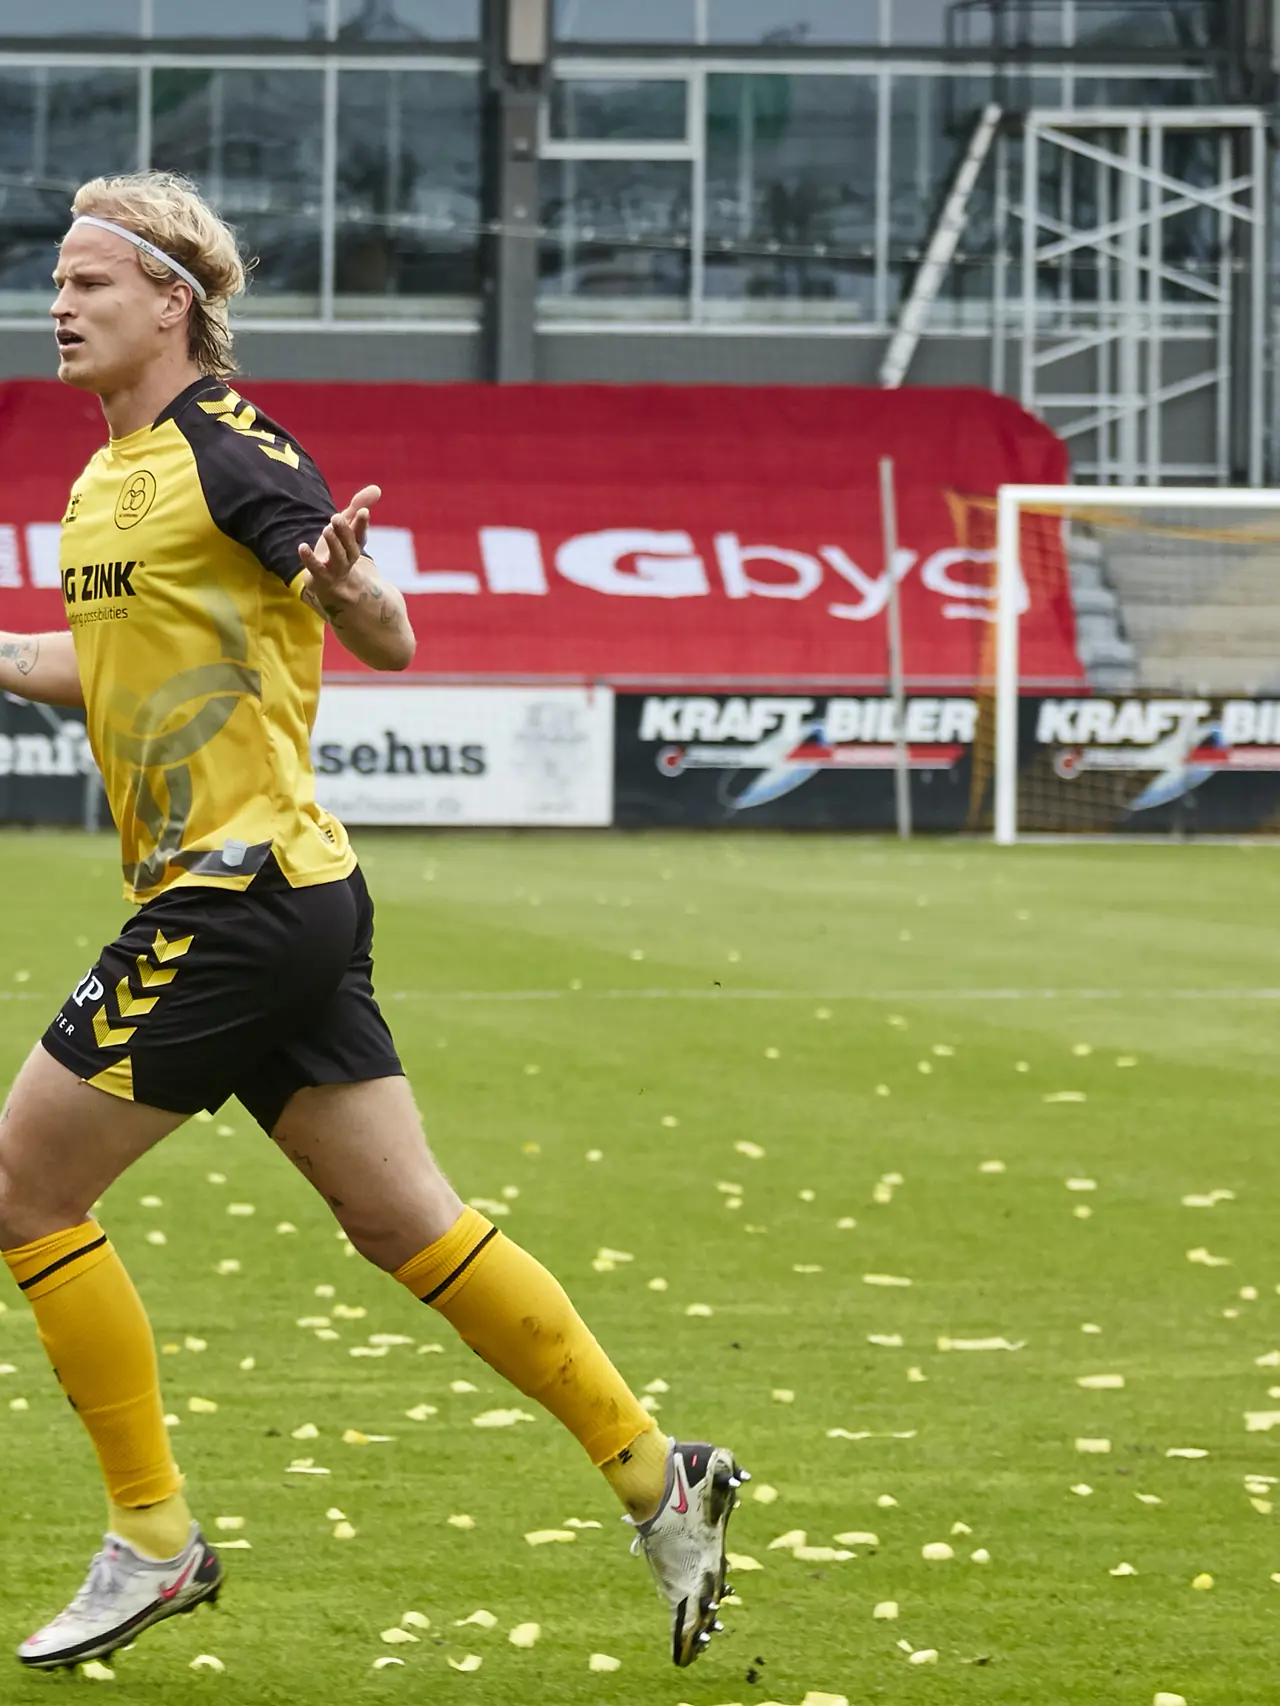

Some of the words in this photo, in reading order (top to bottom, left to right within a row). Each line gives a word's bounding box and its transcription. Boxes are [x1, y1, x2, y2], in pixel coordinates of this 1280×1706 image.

[25, 523, 1031, 622] LIGbyg
[640, 697, 814, 741] KRAFT
[827, 699, 978, 742] BILER
[1034, 699, 1211, 743] KRAFT
[317, 730, 487, 776] sehus
